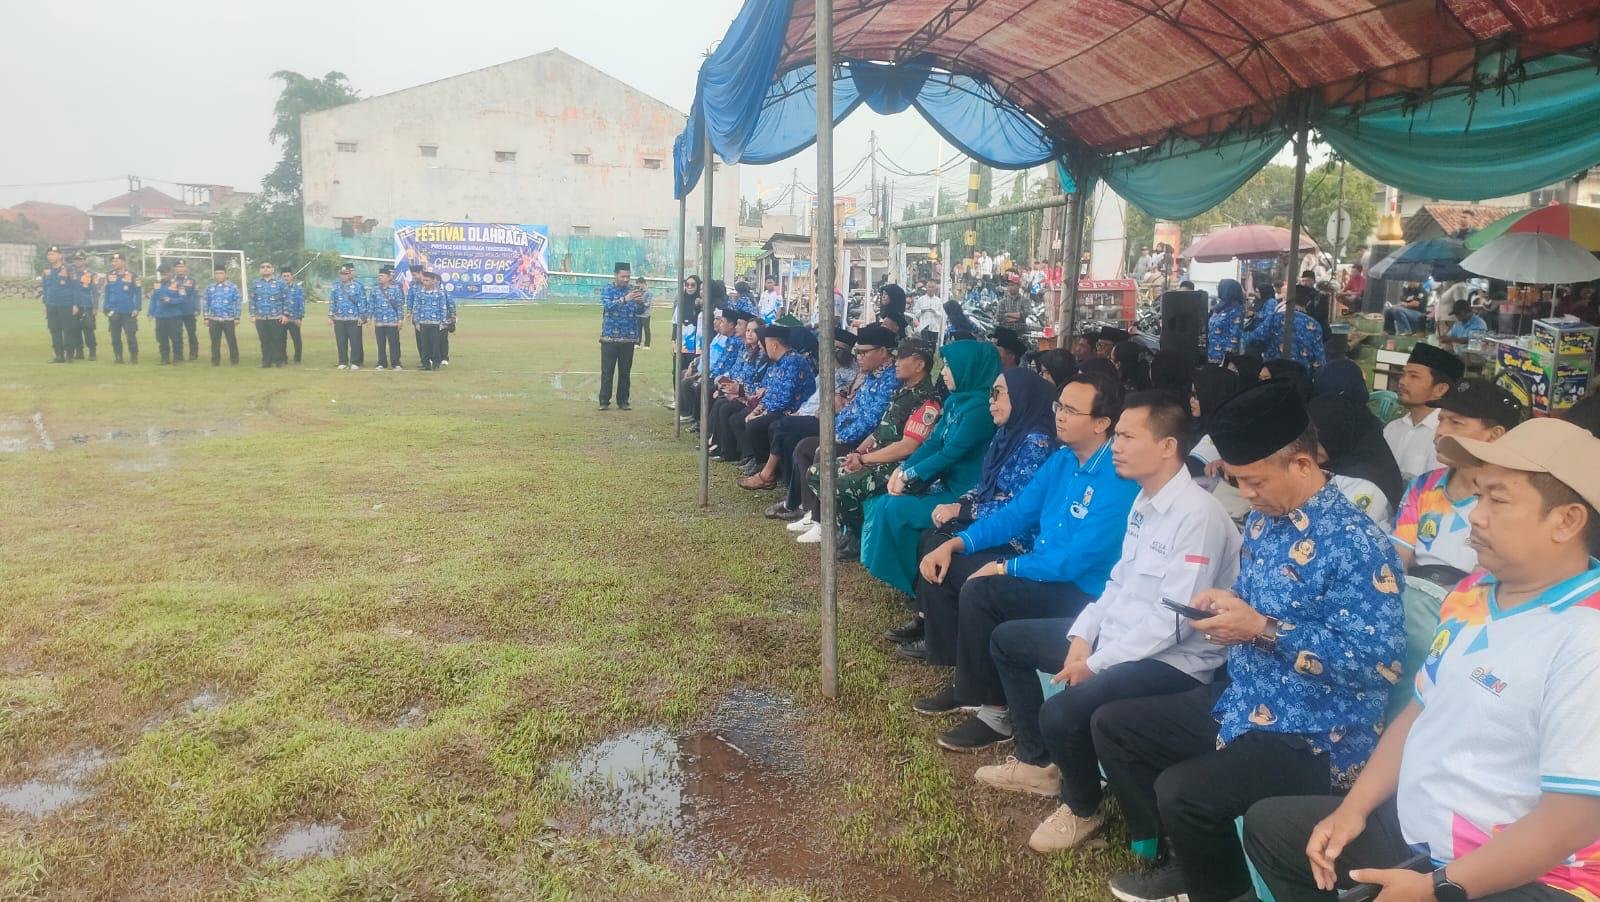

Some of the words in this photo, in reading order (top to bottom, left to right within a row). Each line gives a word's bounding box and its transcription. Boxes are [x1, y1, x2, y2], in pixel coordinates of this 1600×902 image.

[415, 226, 465, 242] FESTIVAL
[468, 226, 528, 247] OLAHRAGA
[434, 257, 482, 270] GENERASI
[484, 259, 513, 271] EMAS
